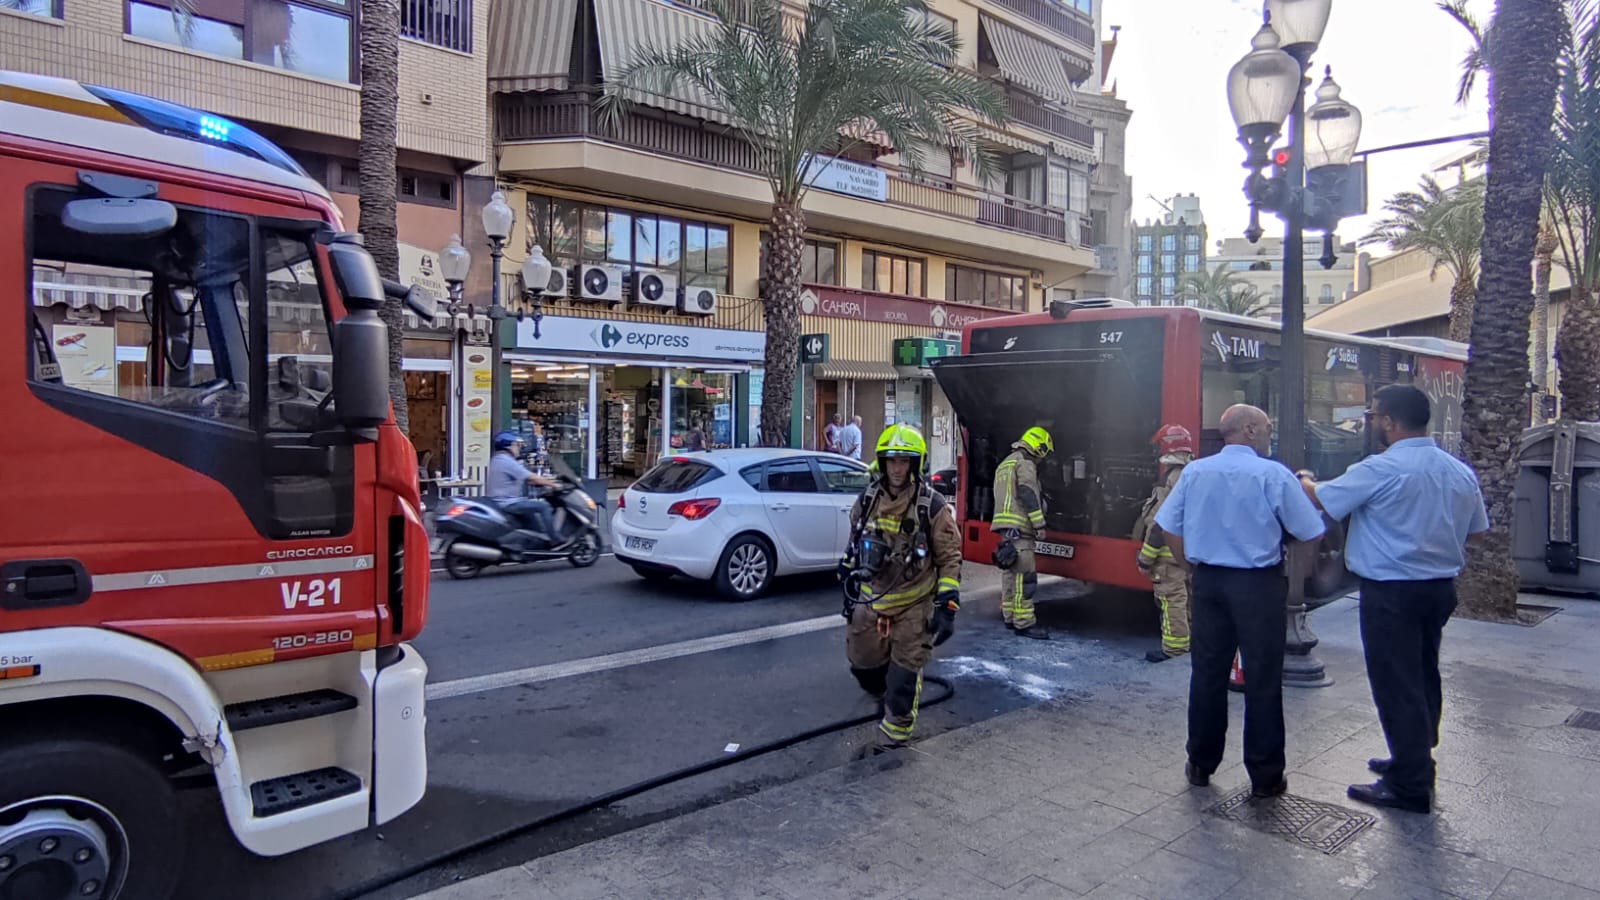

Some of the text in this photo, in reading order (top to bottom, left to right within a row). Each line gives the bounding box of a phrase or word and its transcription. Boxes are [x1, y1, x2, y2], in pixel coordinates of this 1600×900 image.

[849, 174, 879, 189] NAVARRO
[821, 300, 862, 316] CAHISPA
[626, 331, 690, 349] express
[1100, 331, 1123, 343] 547
[1231, 337, 1259, 358] TAM
[266, 545, 354, 559] EUROCARGO
[1035, 542, 1072, 557] 465 FPK
[281, 577, 342, 609] V-21
[272, 629, 353, 649] 120-280
[12, 655, 34, 665] bar
